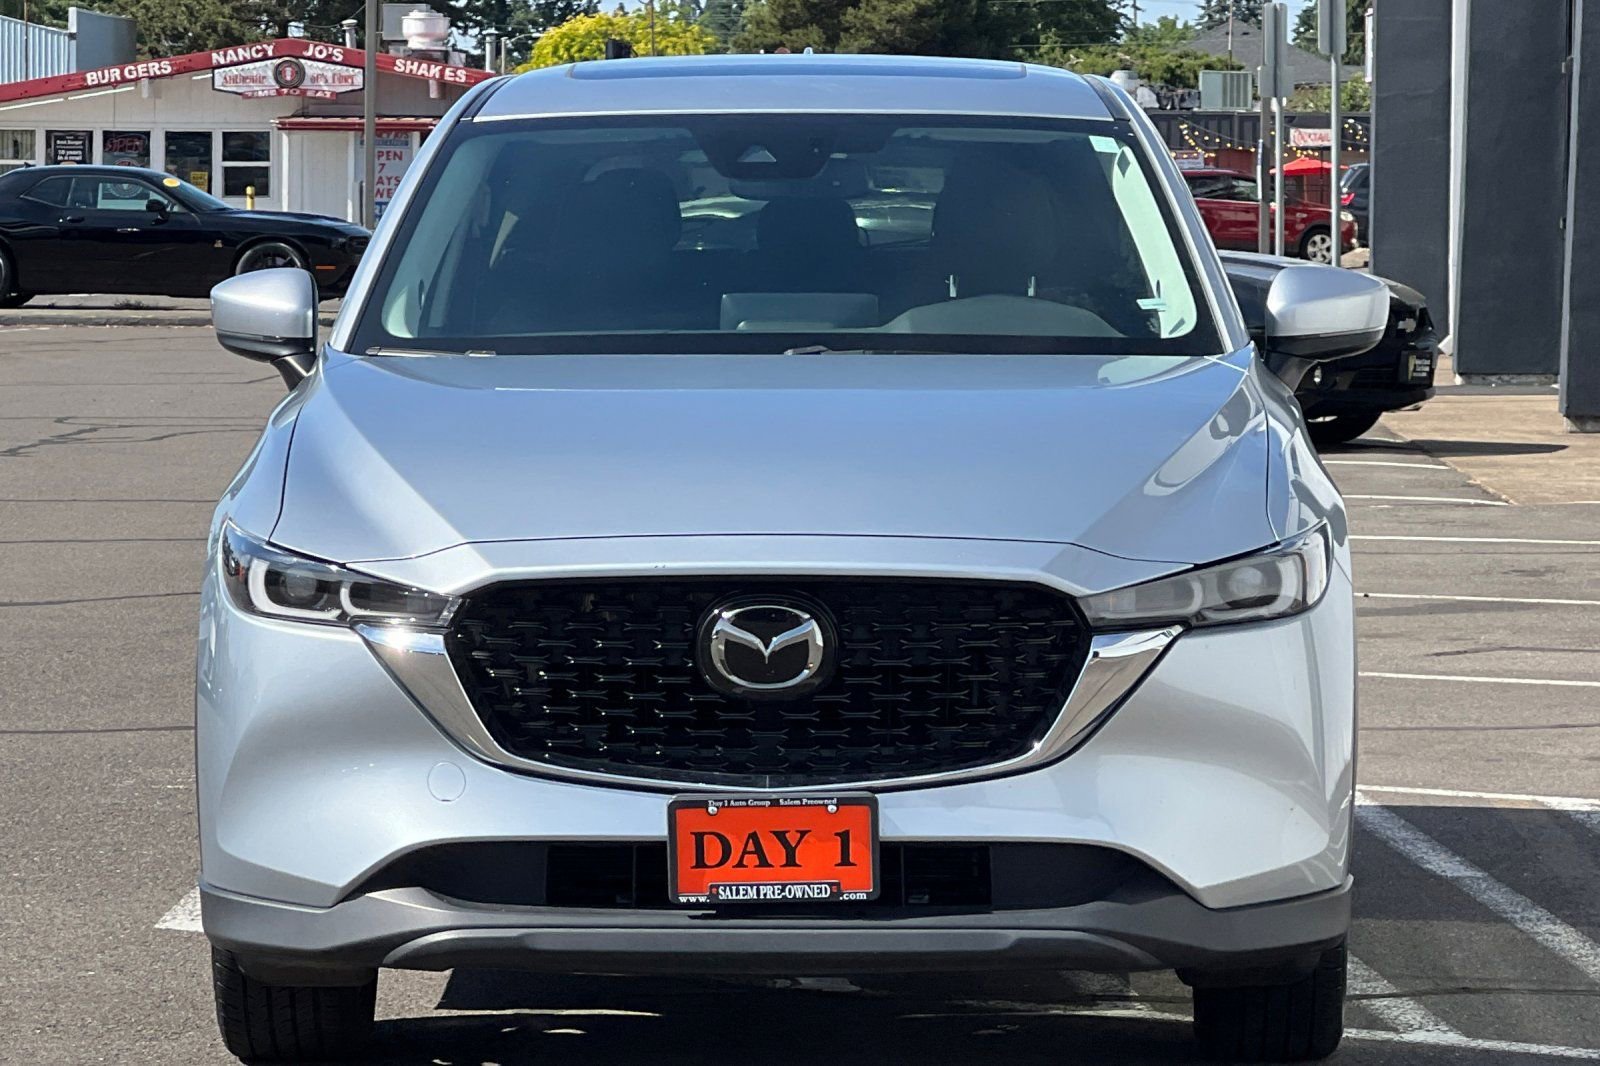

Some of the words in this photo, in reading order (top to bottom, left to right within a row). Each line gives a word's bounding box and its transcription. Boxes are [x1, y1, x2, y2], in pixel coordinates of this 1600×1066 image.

[211, 43, 276, 66] NANCY
[302, 43, 344, 62] JO'S
[86, 60, 172, 86] BURGERS
[393, 58, 467, 83] SHAKES
[280, 88, 301, 96] TO
[305, 91, 333, 99] EAT
[376, 150, 403, 161] PEN
[378, 163, 386, 174] 7
[375, 175, 401, 187] AYS
[748, 799, 771, 807] Group
[690, 830, 812, 869] DAY
[834, 829, 857, 867] 1
[718, 886, 757, 900] SALEM
[759, 884, 831, 899] PRE-OWNED
[839, 891, 867, 900] .com
